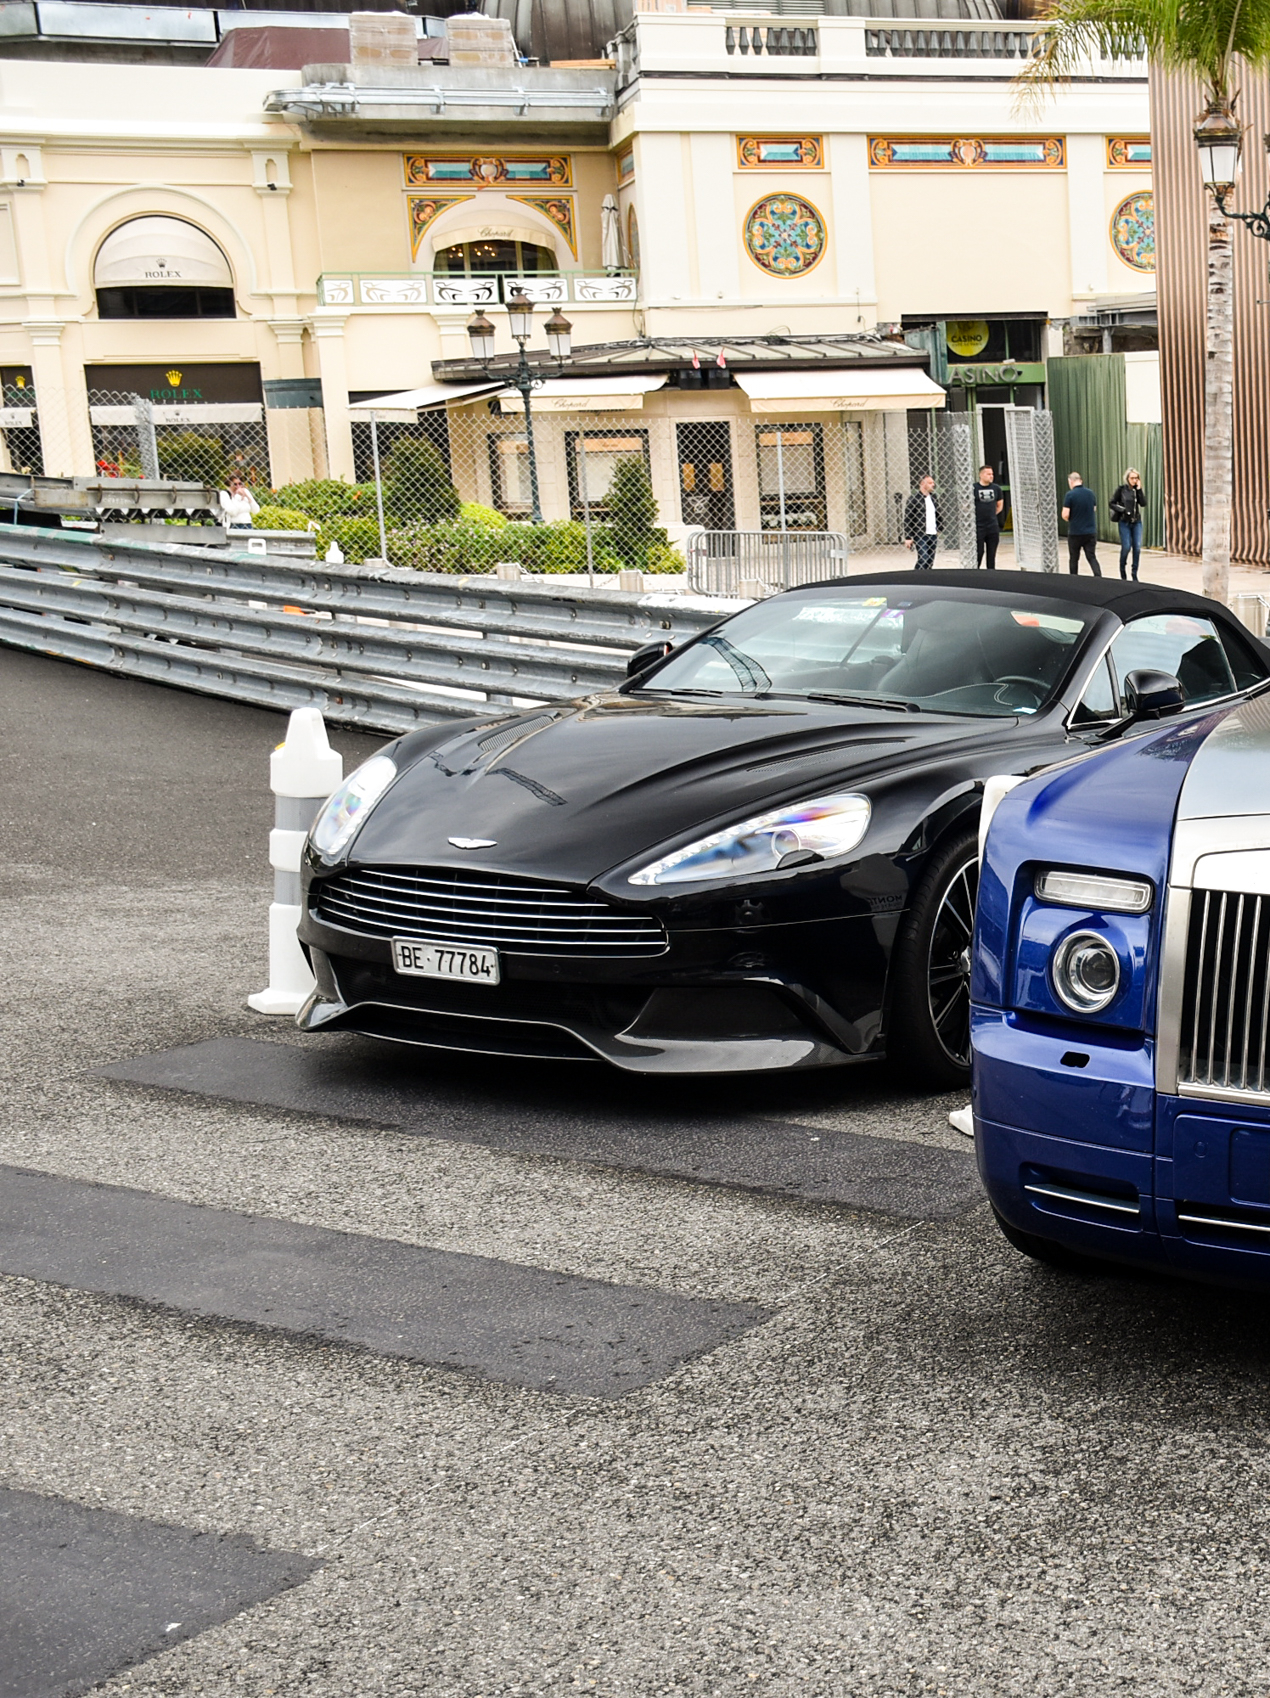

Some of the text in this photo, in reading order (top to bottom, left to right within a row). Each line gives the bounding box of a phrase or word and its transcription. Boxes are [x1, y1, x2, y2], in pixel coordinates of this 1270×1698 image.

[144, 270, 182, 279] ROLEX
[951, 334, 983, 343] CASINO
[150, 388, 203, 399] ROLEX
[551, 397, 590, 411] Chopard
[829, 397, 870, 410] Chopard
[434, 949, 491, 977] 77784
